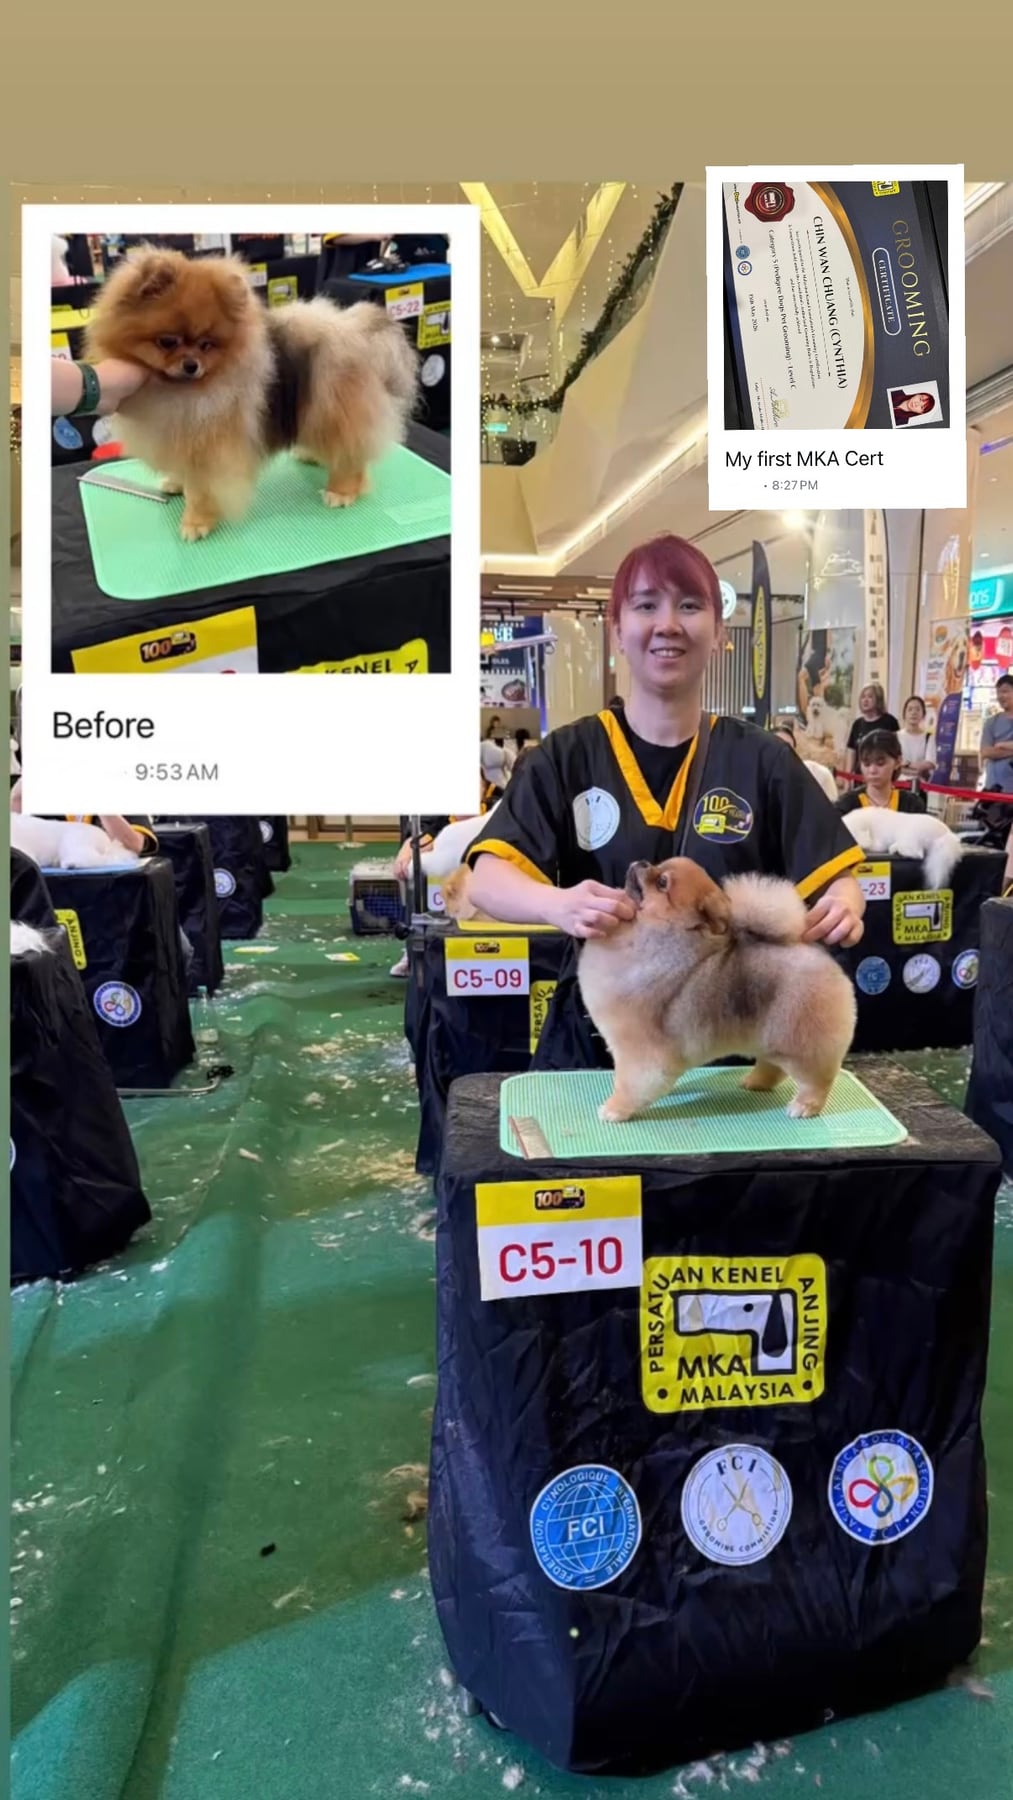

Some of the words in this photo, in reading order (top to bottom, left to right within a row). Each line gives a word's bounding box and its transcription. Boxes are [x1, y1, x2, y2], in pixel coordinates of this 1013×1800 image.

[813, 215, 825, 244] CHIN
[817, 246, 831, 274] WAN
[822, 276, 839, 326] CHUANG
[878, 259, 895, 324] CERTIFICATE
[892, 220, 931, 357] GROOMING
[829, 327, 849, 389] (CYNTHIA)
[140, 642, 171, 662] 100
[453, 968, 522, 989] C5-09
[536, 1191, 562, 1207] 100
[498, 1236, 623, 1283] C5-10
[648, 1267, 703, 1373] PERSATUAN
[711, 1266, 784, 1284] KENEL
[798, 1277, 819, 1371] ANJING
[676, 1353, 750, 1381] MKA
[680, 1382, 795, 1405] MALAYSIA
[716, 1455, 758, 1476] FCI
[540, 1470, 610, 1511] CYNOLOGIQUE
[567, 1515, 605, 1541] FCI
[534, 1518, 575, 1583] FEDERATION
